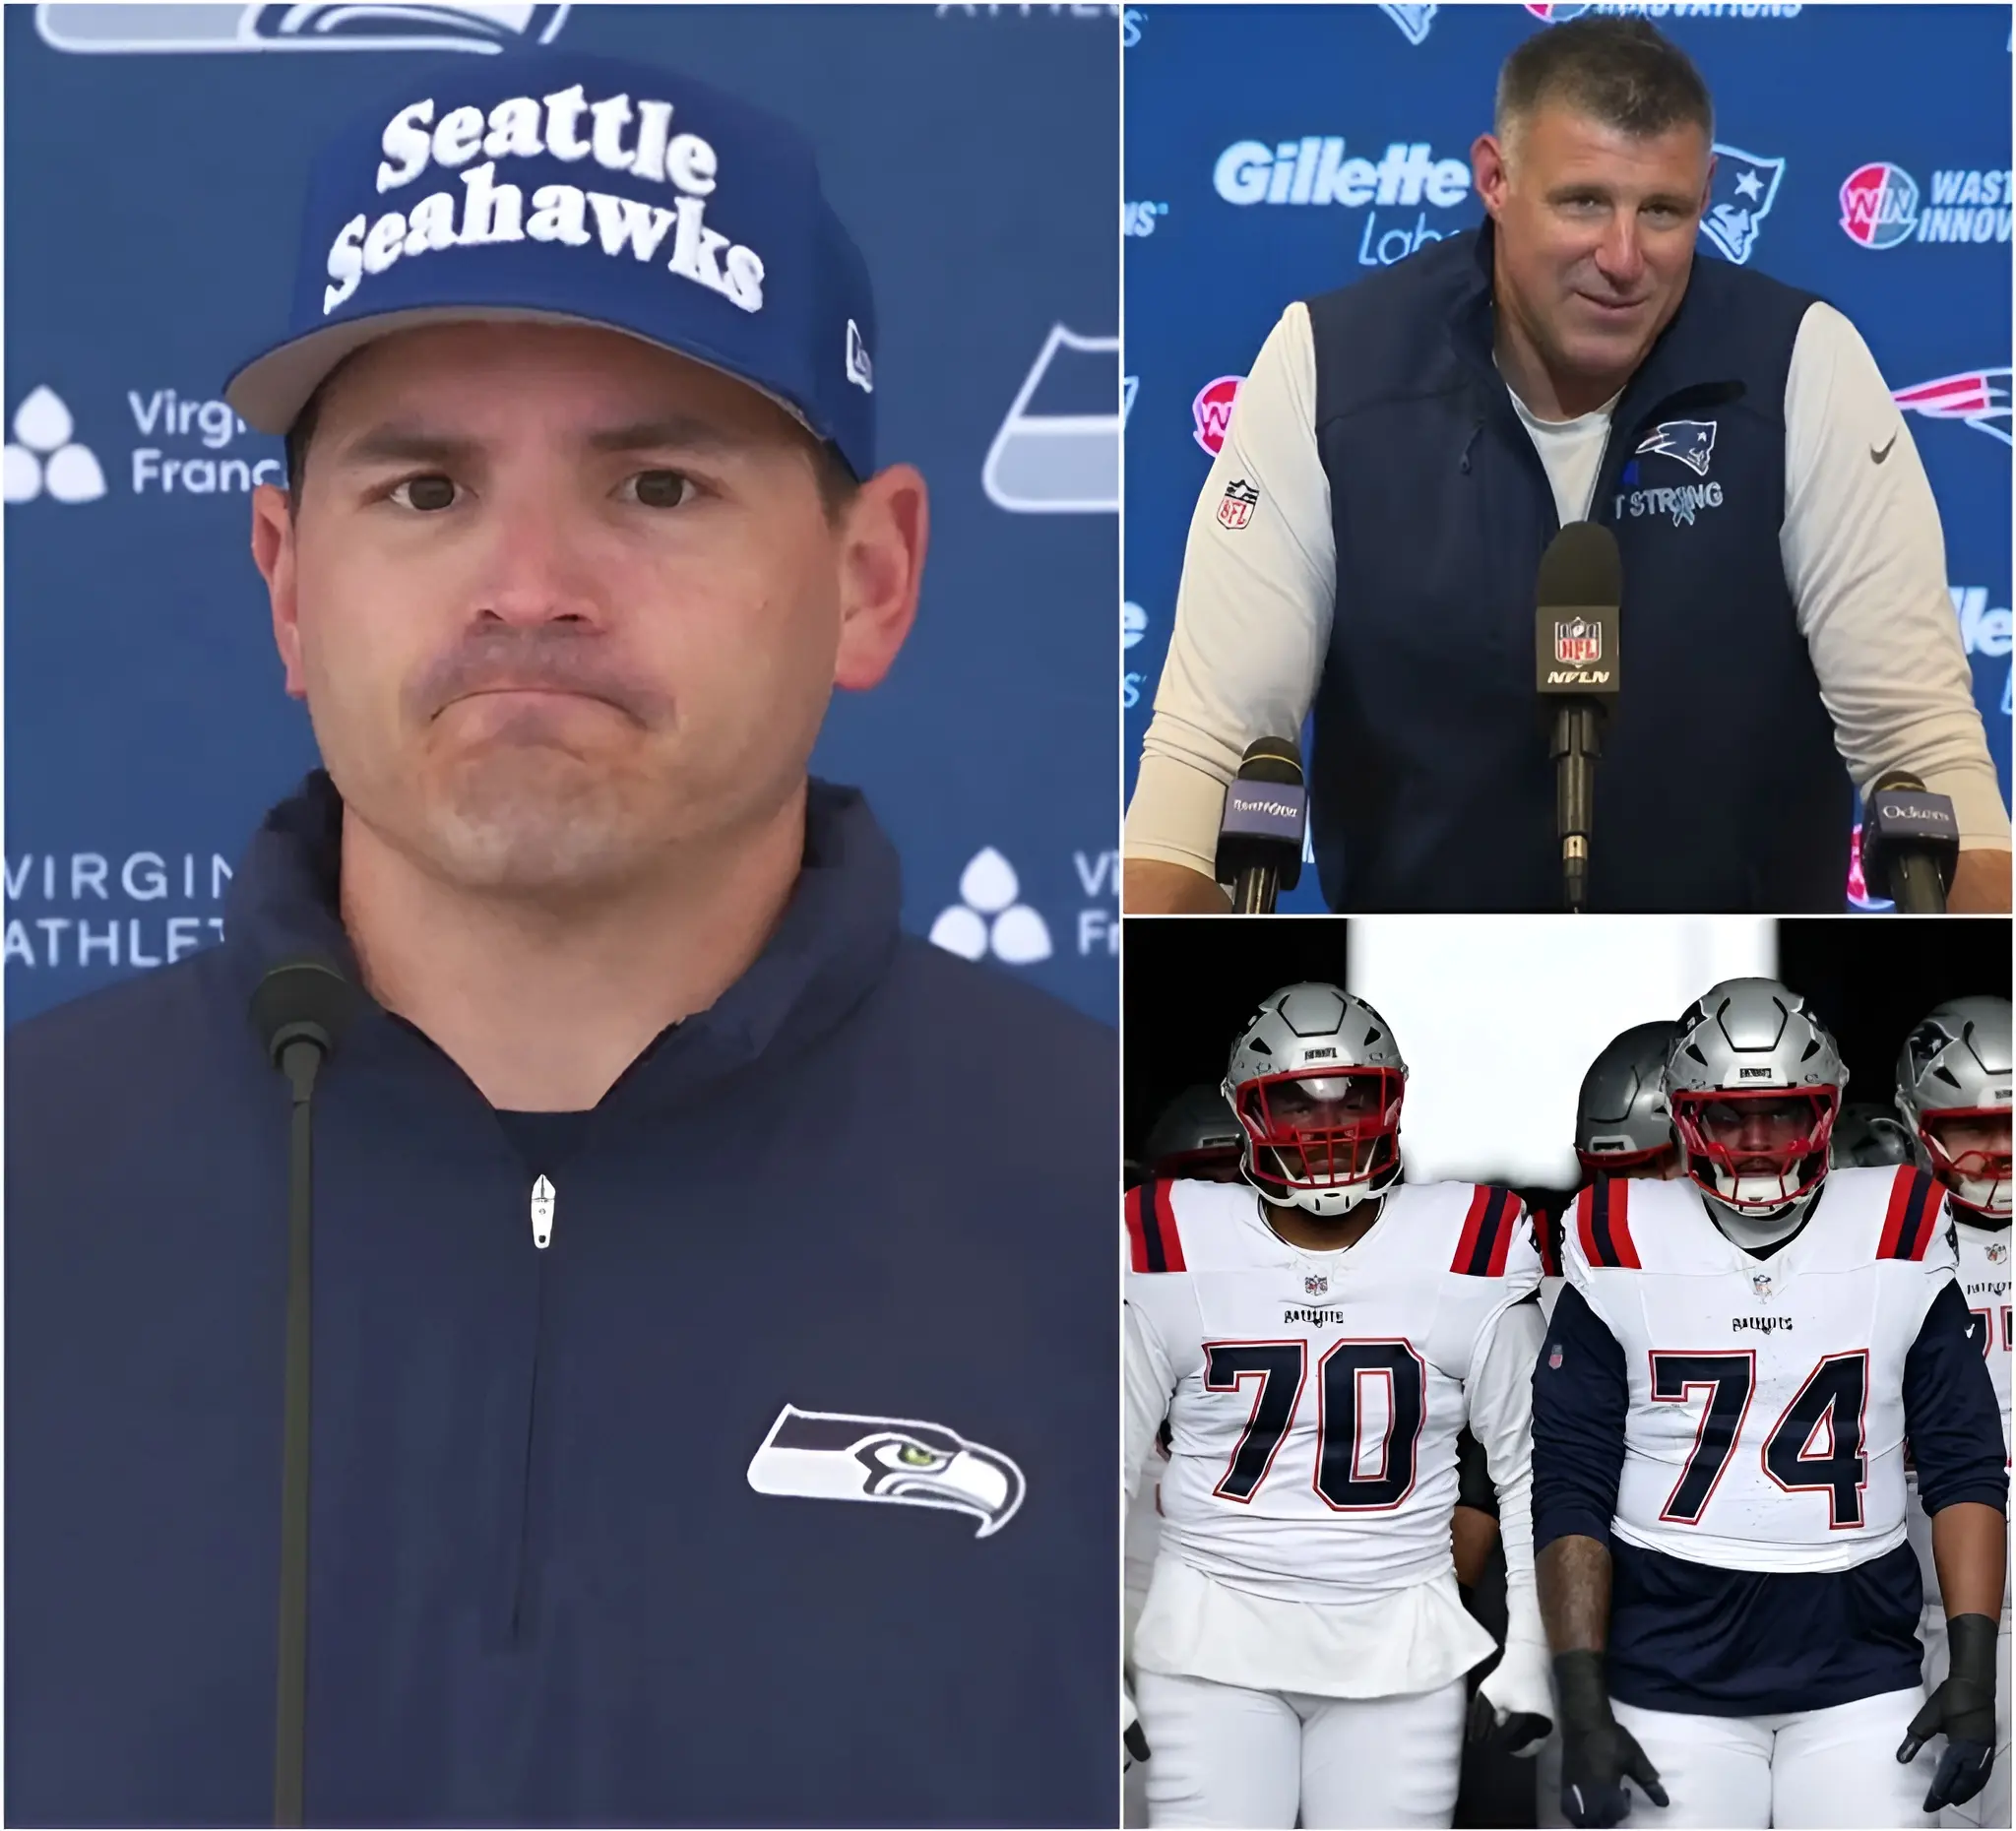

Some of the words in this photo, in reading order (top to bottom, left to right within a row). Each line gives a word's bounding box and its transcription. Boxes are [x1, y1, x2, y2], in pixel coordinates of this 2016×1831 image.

[376, 83, 718, 197] Seattle
[1213, 136, 1472, 208] Gillette
[323, 161, 765, 315] Seahawks
[128, 389, 246, 449] Virg
[1201, 1337, 1427, 1513] 70
[1648, 1348, 1869, 1531] 74
